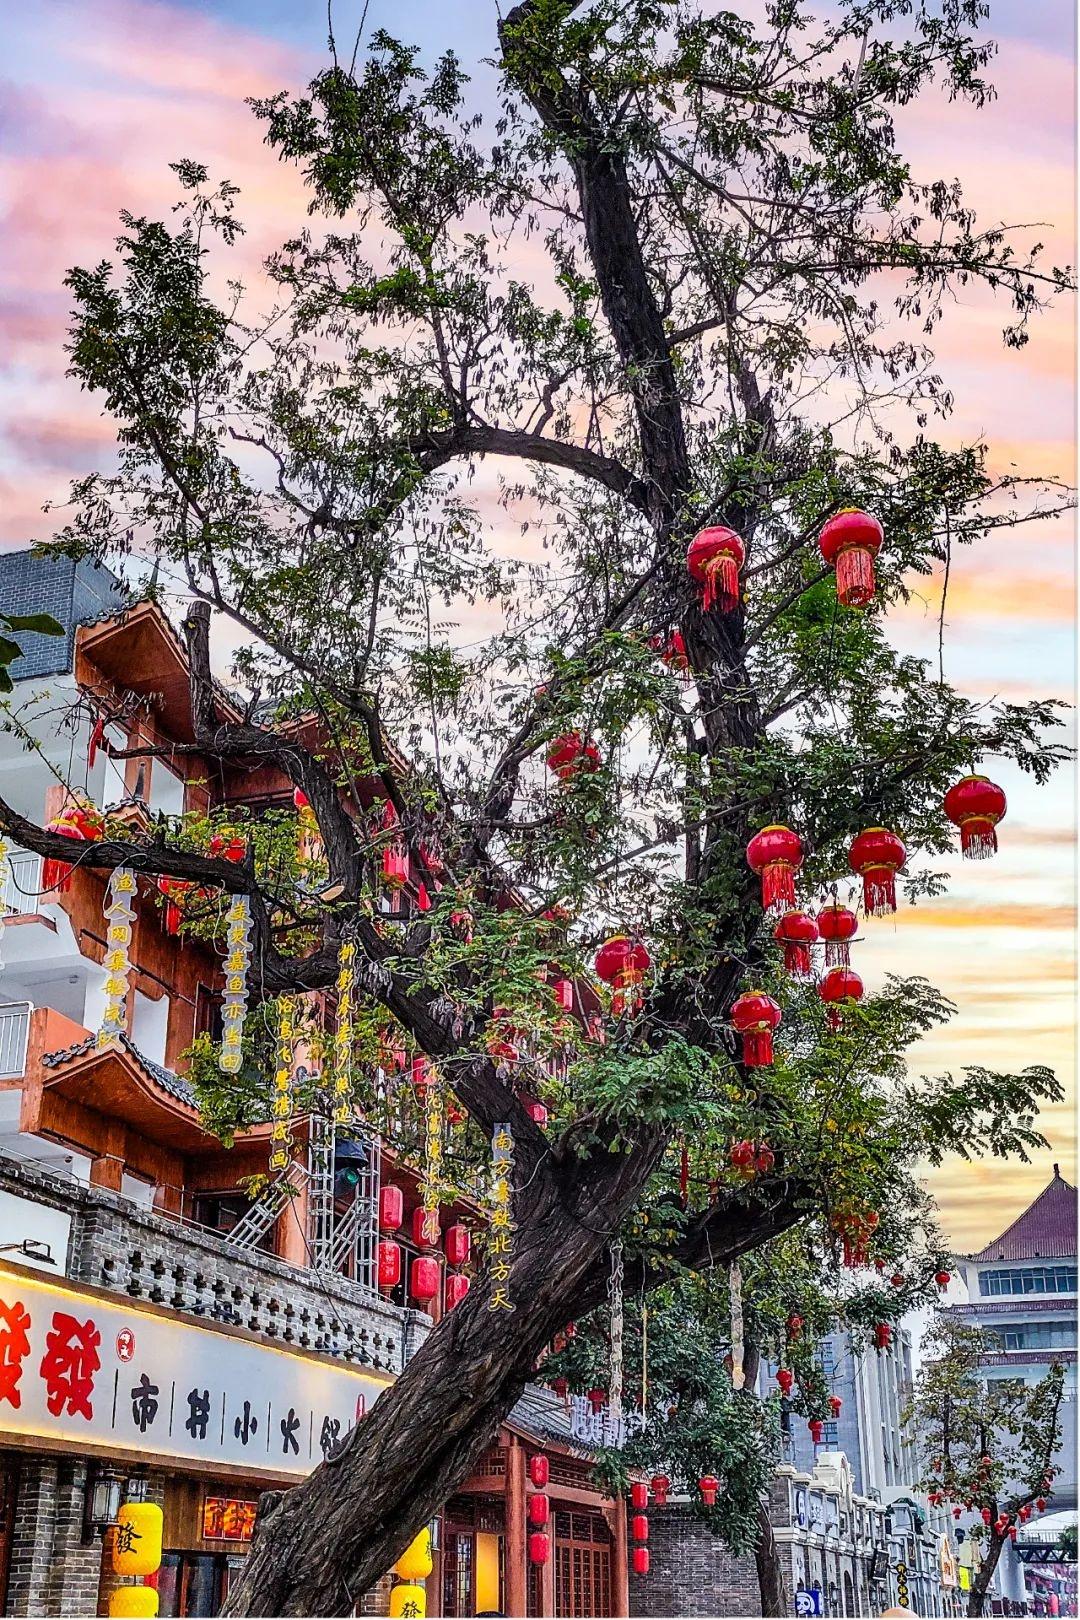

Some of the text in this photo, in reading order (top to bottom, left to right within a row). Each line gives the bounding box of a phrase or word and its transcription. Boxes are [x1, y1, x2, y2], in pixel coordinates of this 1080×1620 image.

[490, 1129, 515, 1309] 南方景致北方天
[117, 1521, 142, 1554] 發
